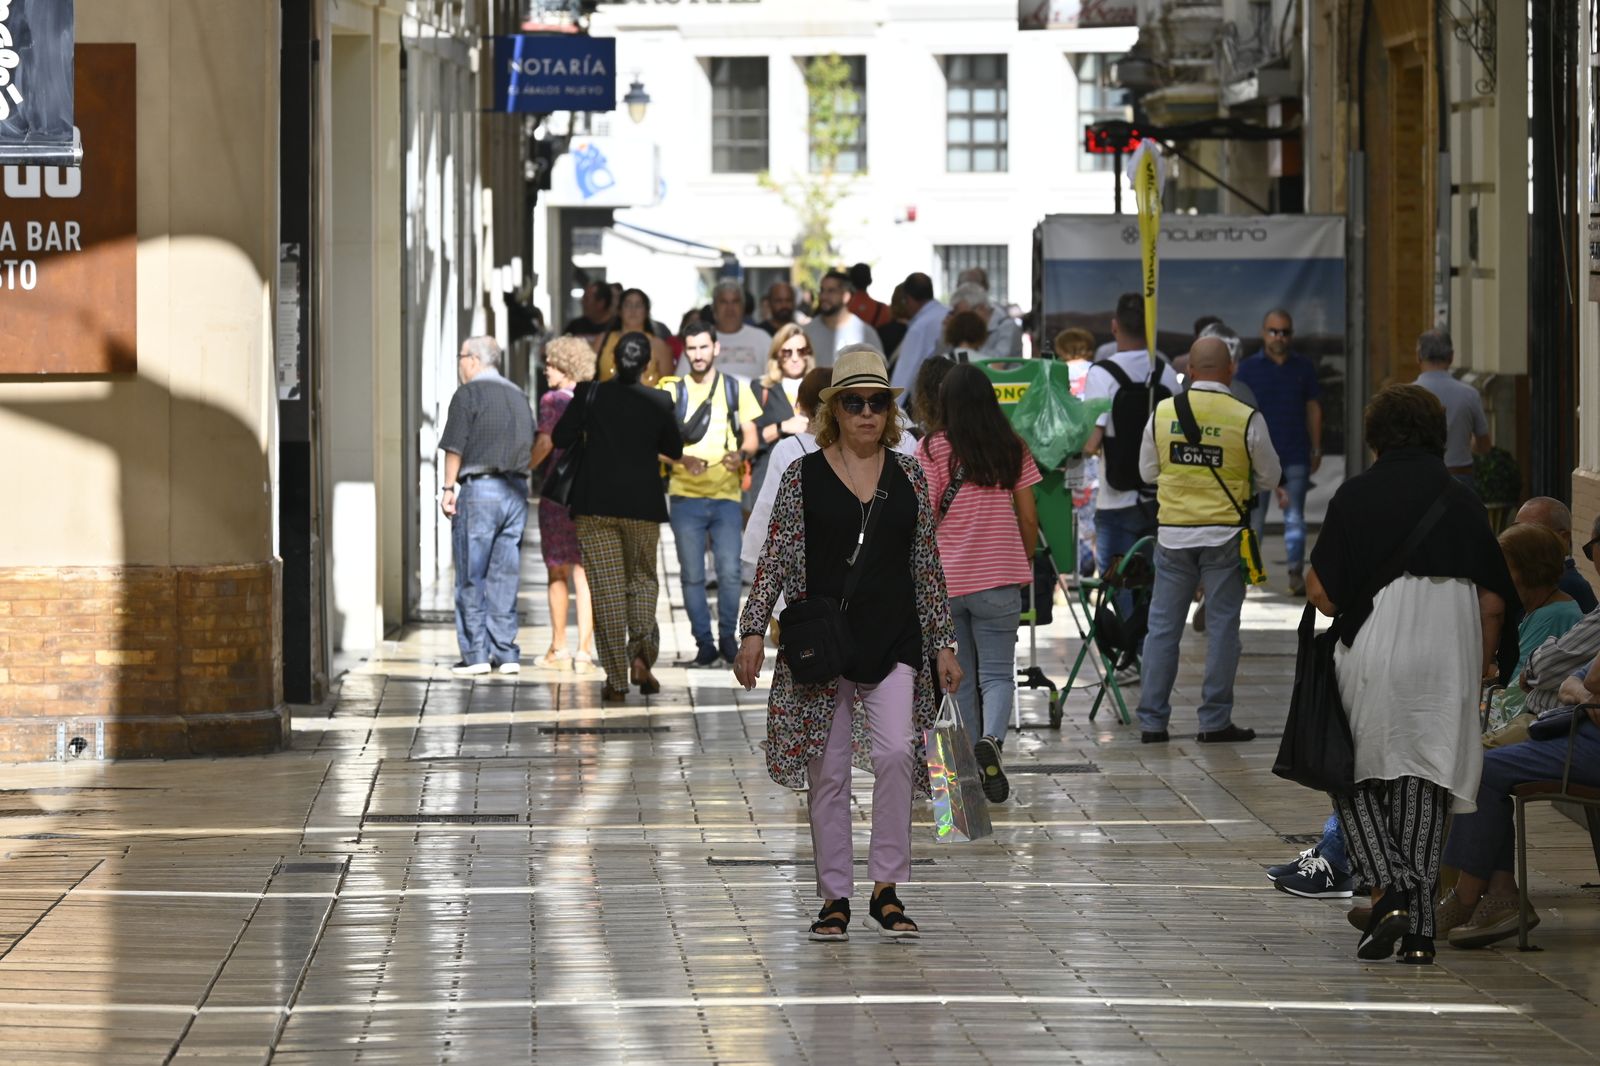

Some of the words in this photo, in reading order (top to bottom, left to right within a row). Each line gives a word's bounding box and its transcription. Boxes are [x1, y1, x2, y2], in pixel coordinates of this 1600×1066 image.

[508, 53, 606, 75] NOTARÍA
[26, 221, 82, 251] BAR
[1160, 226, 1268, 243] ncuentro
[0, 259, 37, 290] TO
